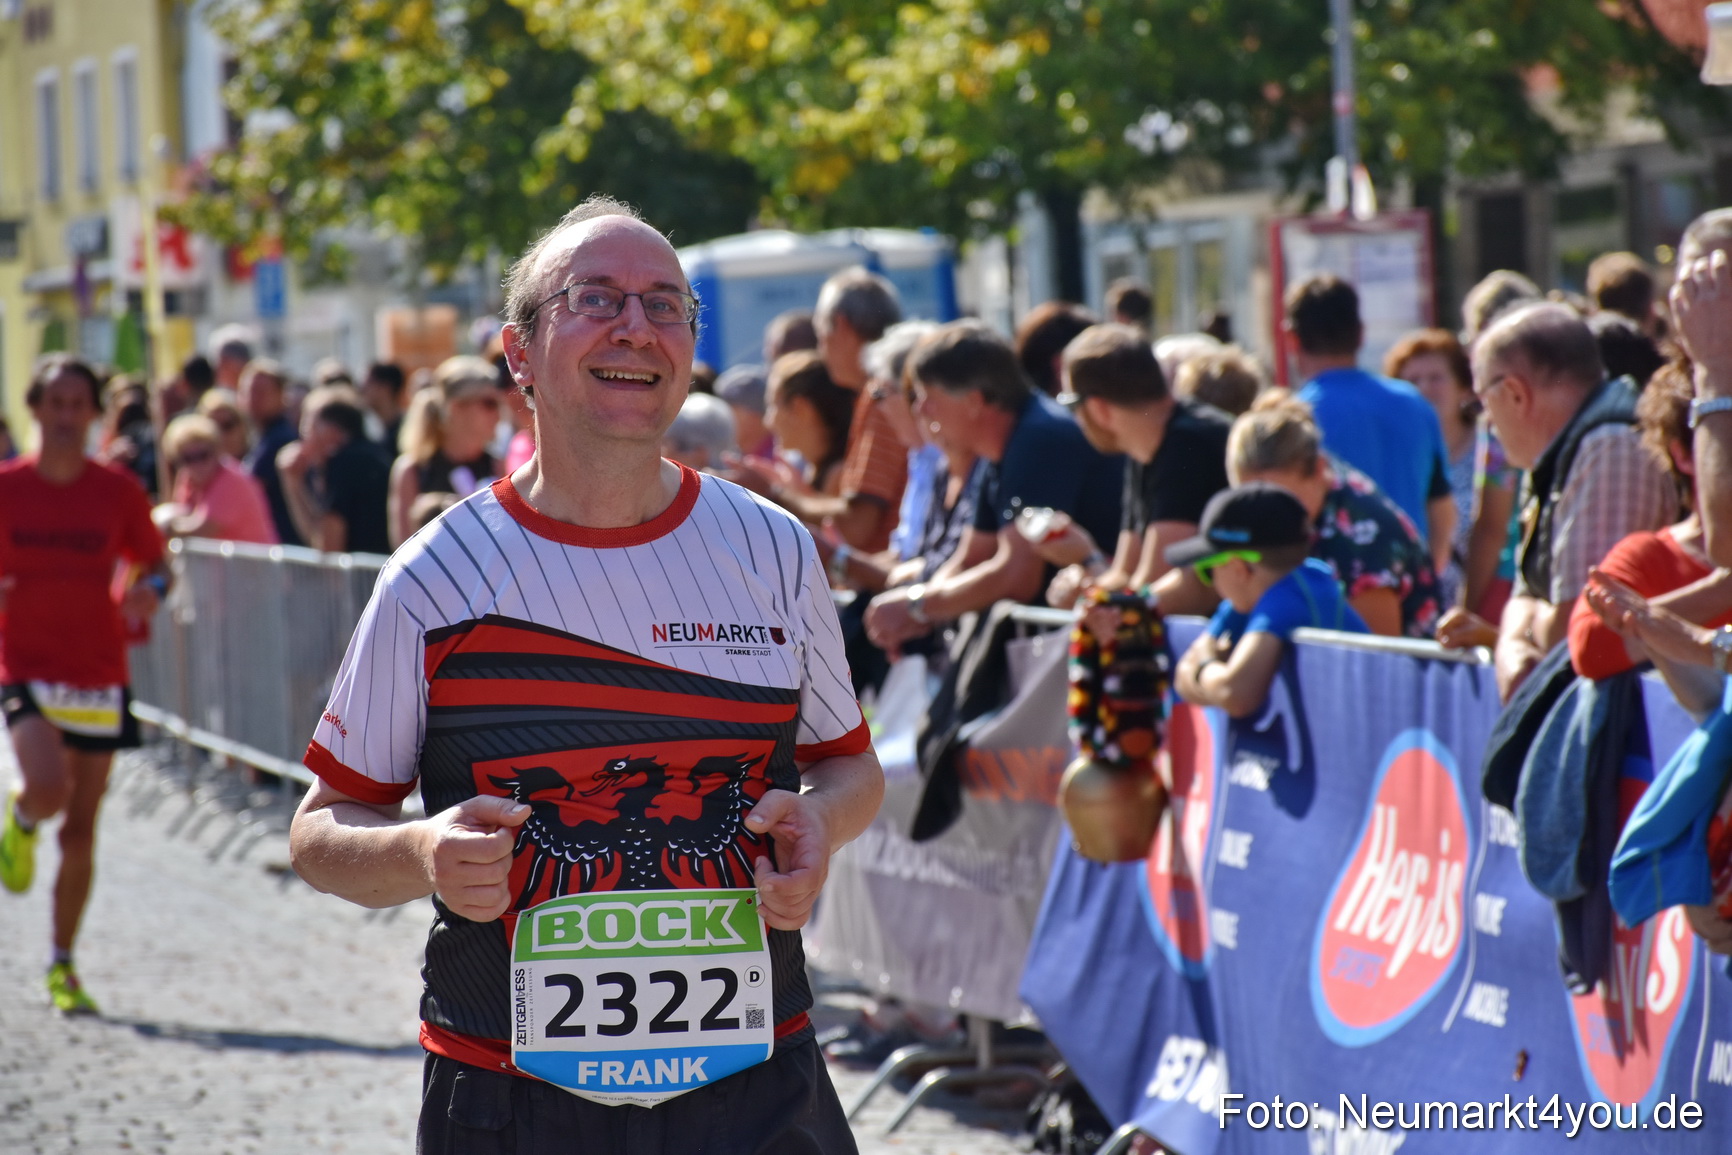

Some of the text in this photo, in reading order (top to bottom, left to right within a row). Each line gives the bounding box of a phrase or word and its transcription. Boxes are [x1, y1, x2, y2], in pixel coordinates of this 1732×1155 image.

[652, 623, 766, 644] NEUMARKT
[725, 648, 772, 657] STARKE STADT
[1333, 803, 1463, 979] Hervis
[535, 902, 738, 949] BOCK
[749, 970, 760, 983] D
[543, 967, 740, 1039] 2322
[577, 1056, 710, 1086] FRANK
